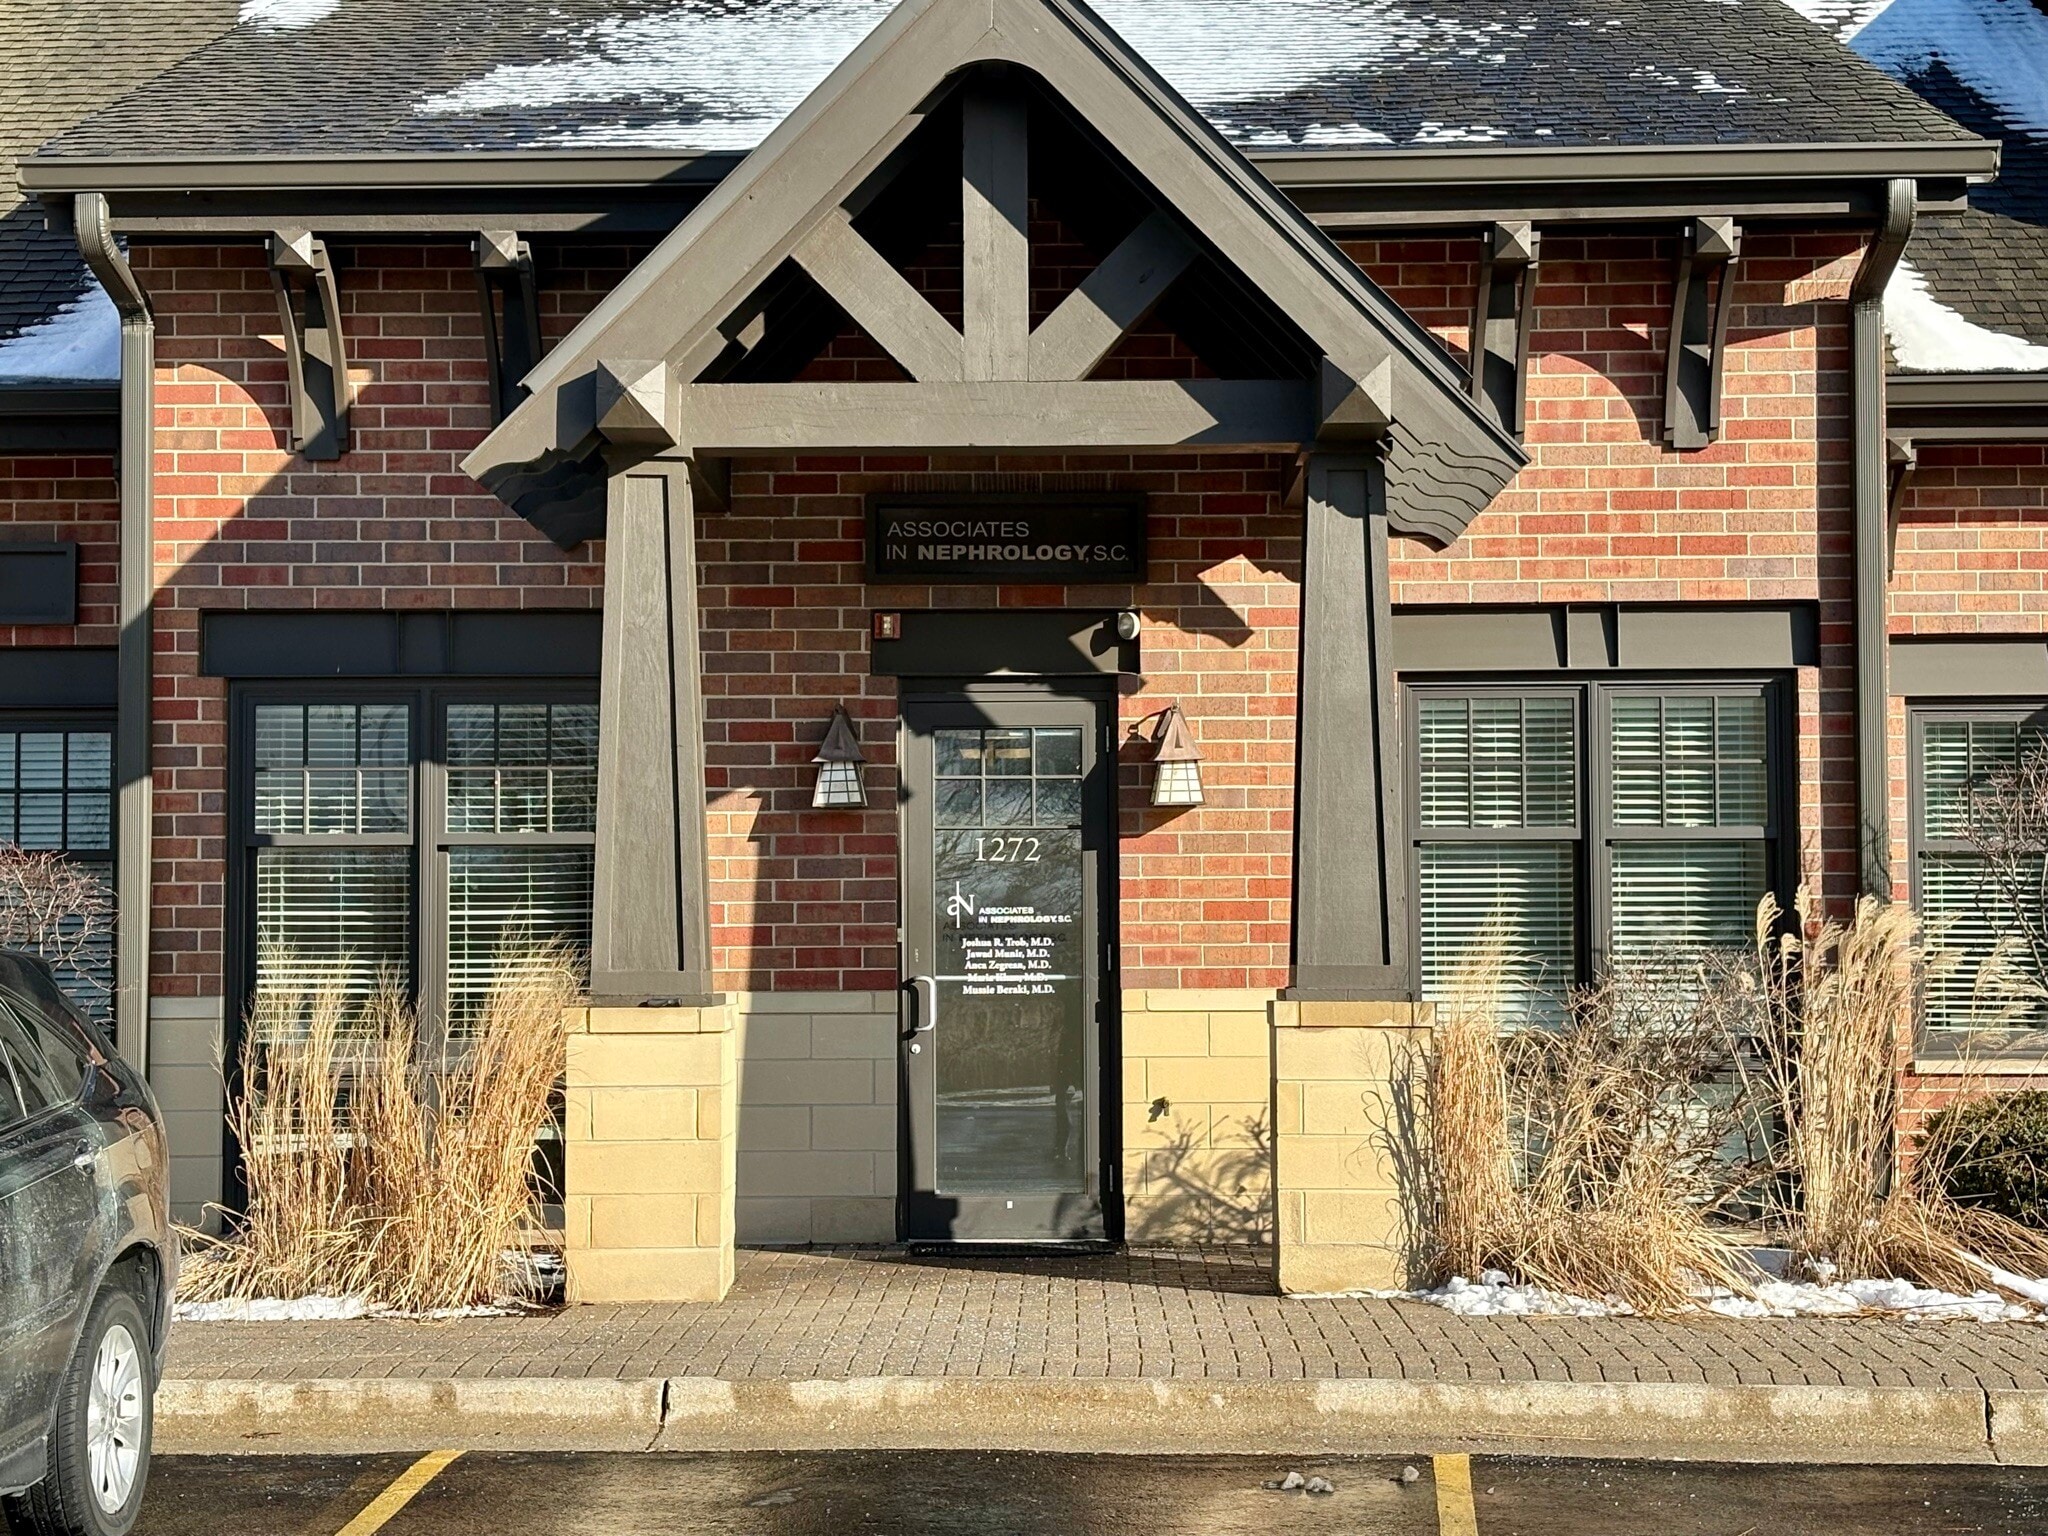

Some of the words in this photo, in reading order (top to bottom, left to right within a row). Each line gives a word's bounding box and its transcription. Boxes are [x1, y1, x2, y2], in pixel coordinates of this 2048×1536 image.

[887, 521, 1030, 538] ASSOCIATES
[886, 544, 907, 560] IN
[917, 544, 1090, 563] NEPHROLOGY,
[1093, 545, 1129, 561] S.C.
[975, 837, 1041, 863] 1272
[978, 906, 1034, 915] ASSOCIATES
[961, 937, 992, 949] Joshua
[993, 937, 1004, 947] R.
[1005, 937, 1029, 948] Trob,
[1030, 937, 1055, 947] M.D.
[965, 948, 993, 960] Jawad
[994, 949, 1025, 959] Munir,
[1026, 948, 1051, 958] M.D.
[964, 960, 987, 970] Anca
[1027, 960, 1052, 969] M.D.
[1024, 972, 1049, 982] M.D.
[962, 985, 995, 995] Mussie
[996, 984, 1030, 995] Beraki,
[1031, 984, 1056, 994] M.D.
